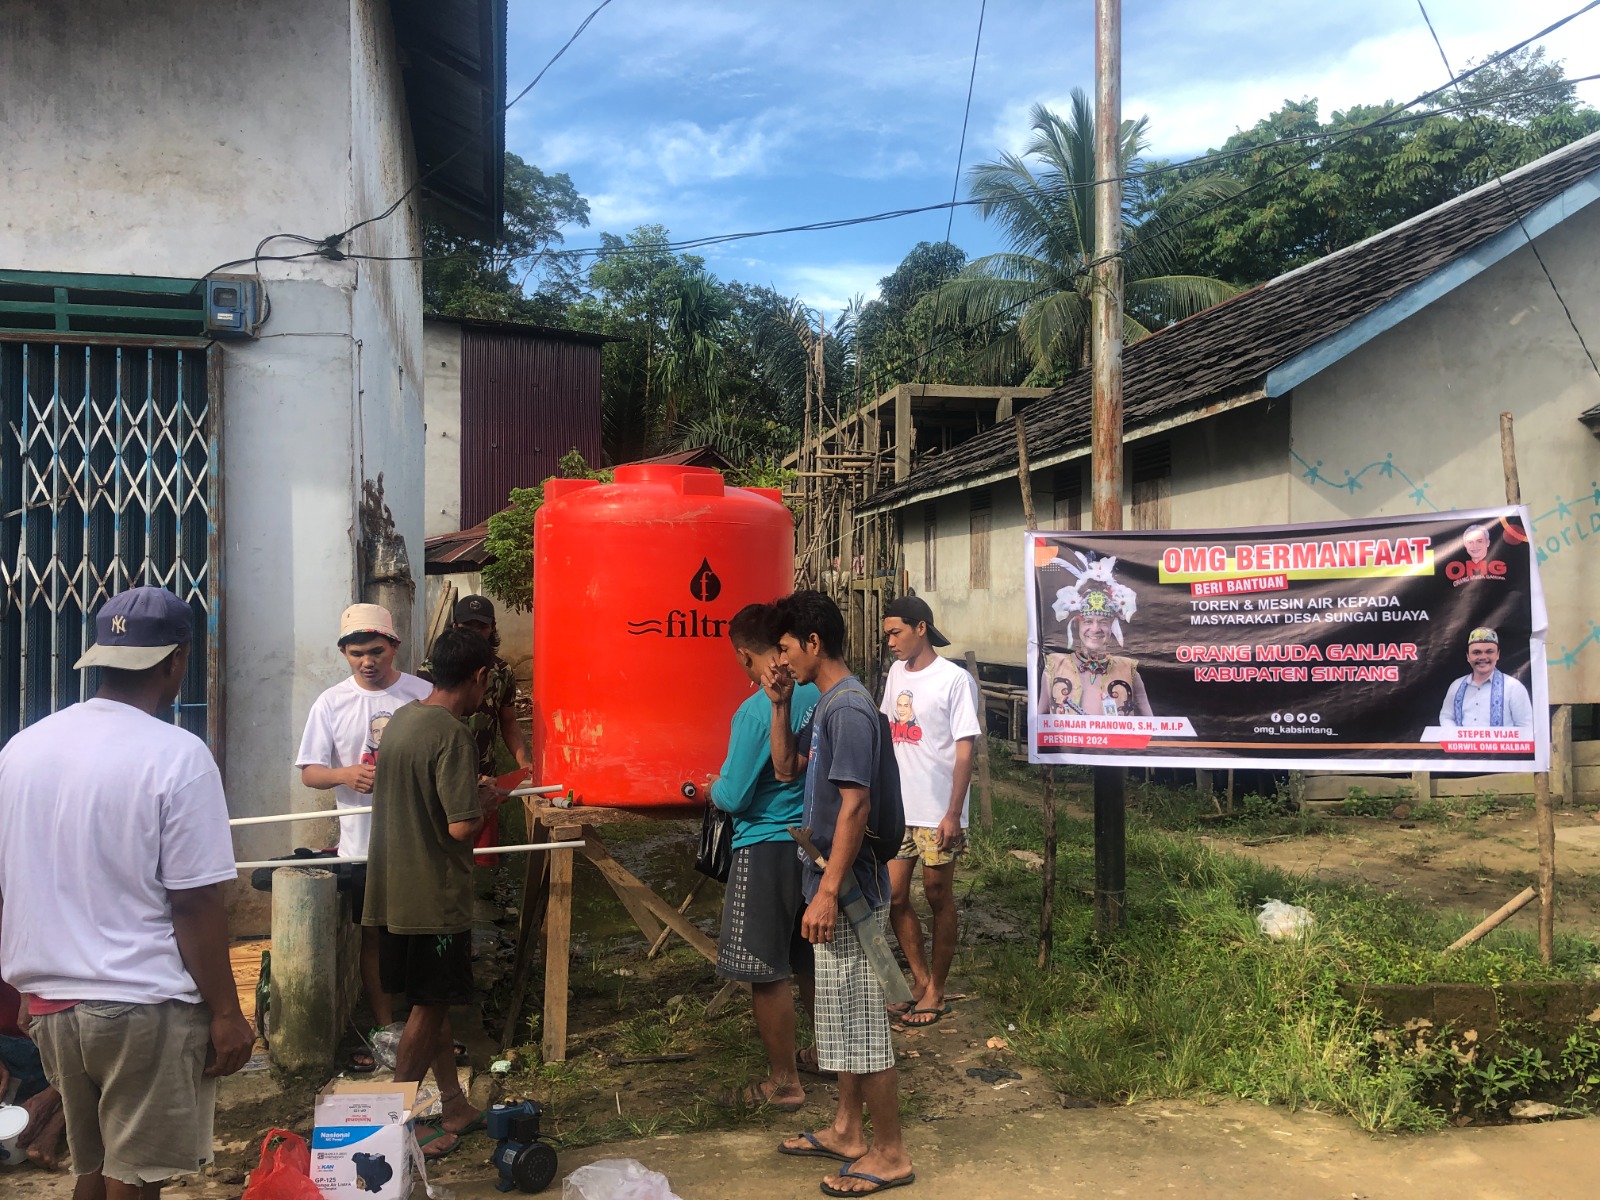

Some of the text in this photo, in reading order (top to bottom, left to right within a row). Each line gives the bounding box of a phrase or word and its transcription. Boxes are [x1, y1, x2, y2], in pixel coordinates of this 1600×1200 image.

[1163, 537, 1431, 574] OMG BERMANFAAT
[1445, 560, 1507, 580] OMG
[1194, 576, 1284, 595] BERI BANTUAN
[1190, 595, 1401, 612] TOREN & MESIN AIR KEPADA
[665, 609, 732, 638] filtr
[1190, 610, 1430, 625] MASYARAKAT DESA SUNGAI BUAYA
[1176, 643, 1418, 662] ORANG MUDA GANJAR
[1194, 665, 1399, 682] KABUPATEN SINTANG
[1043, 719, 1051, 728] H.
[1053, 719, 1087, 729] GANJAR
[1089, 720, 1136, 731] PRANOWO,
[1160, 722, 1184, 731] M.I.P
[1253, 725, 1339, 736] omg_kabsintang_
[1043, 734, 1108, 745] PRESIDEN 2024
[1457, 730, 1520, 739] STEPER VIJAE
[1447, 743, 1531, 751] KORWIL OMG KALBAR
[320, 1131, 350, 1139] Nasional
